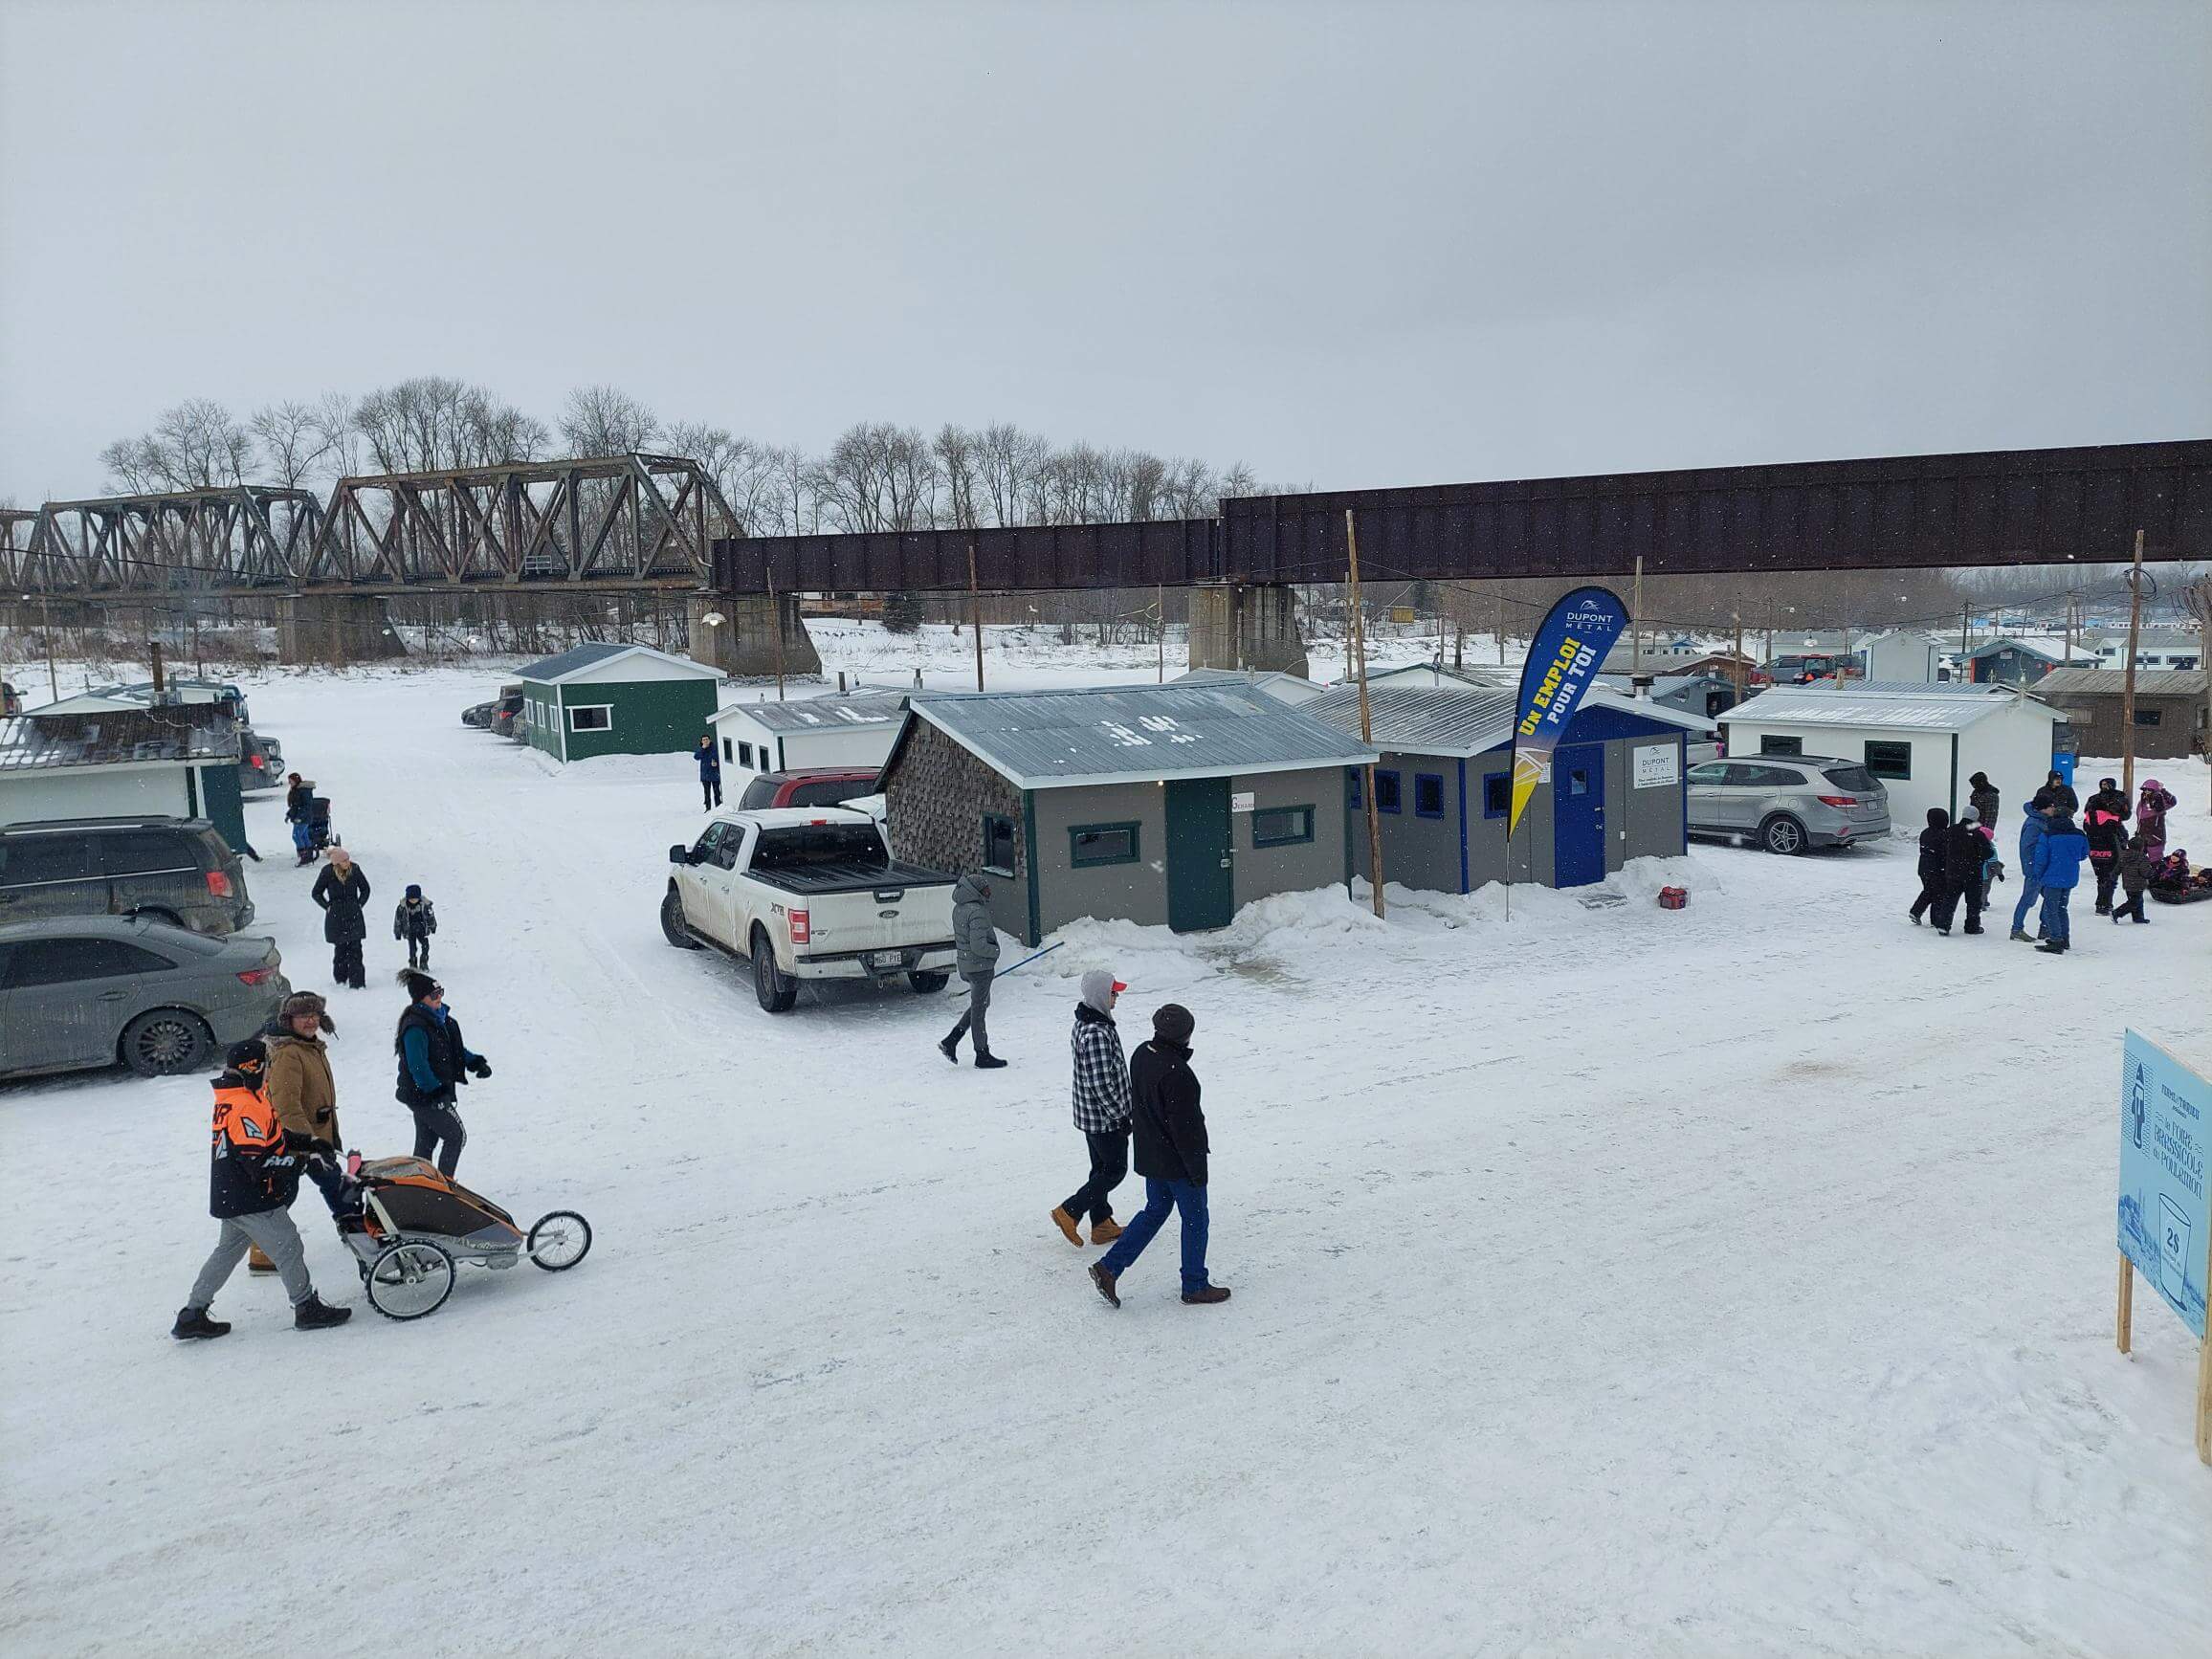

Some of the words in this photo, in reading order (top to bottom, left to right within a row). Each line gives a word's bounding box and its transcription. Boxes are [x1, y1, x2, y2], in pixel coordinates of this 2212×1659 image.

[1566, 612, 1614, 623] DUPONT
[1518, 709, 1542, 736] UN
[1533, 636, 1581, 709] EMPLOI
[1547, 682, 1577, 724] POUR
[1568, 644, 1597, 677] TOI
[1642, 757, 1670, 766] DUPONT
